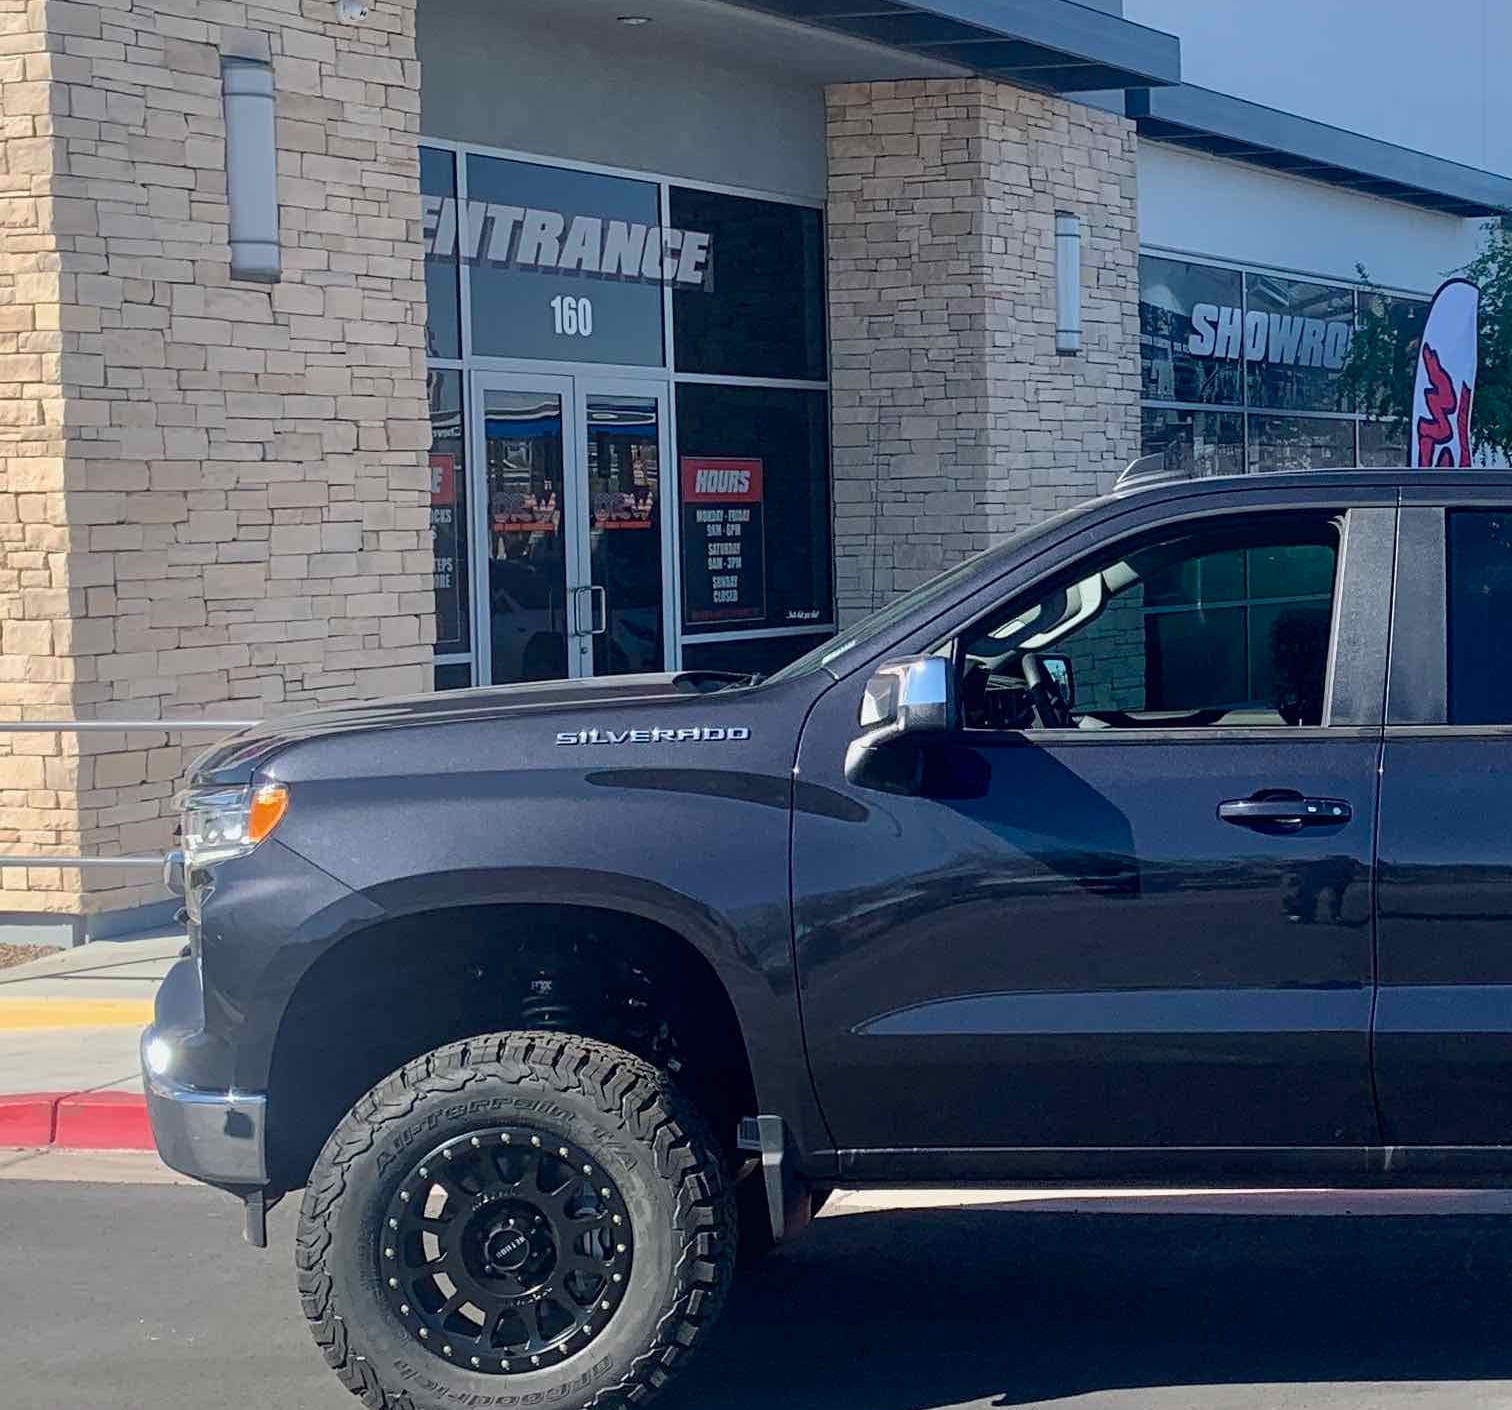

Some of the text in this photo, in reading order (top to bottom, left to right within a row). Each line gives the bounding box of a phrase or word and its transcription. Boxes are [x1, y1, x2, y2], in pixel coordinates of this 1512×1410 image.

[420, 194, 712, 286] ENTRANCE
[550, 295, 592, 336] 160
[1188, 303, 1354, 369] SHOWRO
[695, 469, 751, 493] HOURS
[696, 509, 724, 522] MONDAY
[728, 509, 751, 522] FRIDAY
[708, 542, 741, 555] SATURDAY
[712, 576, 738, 589] SUNDAY
[713, 590, 738, 603] CLOSED
[556, 727, 750, 746] SILVERADO
